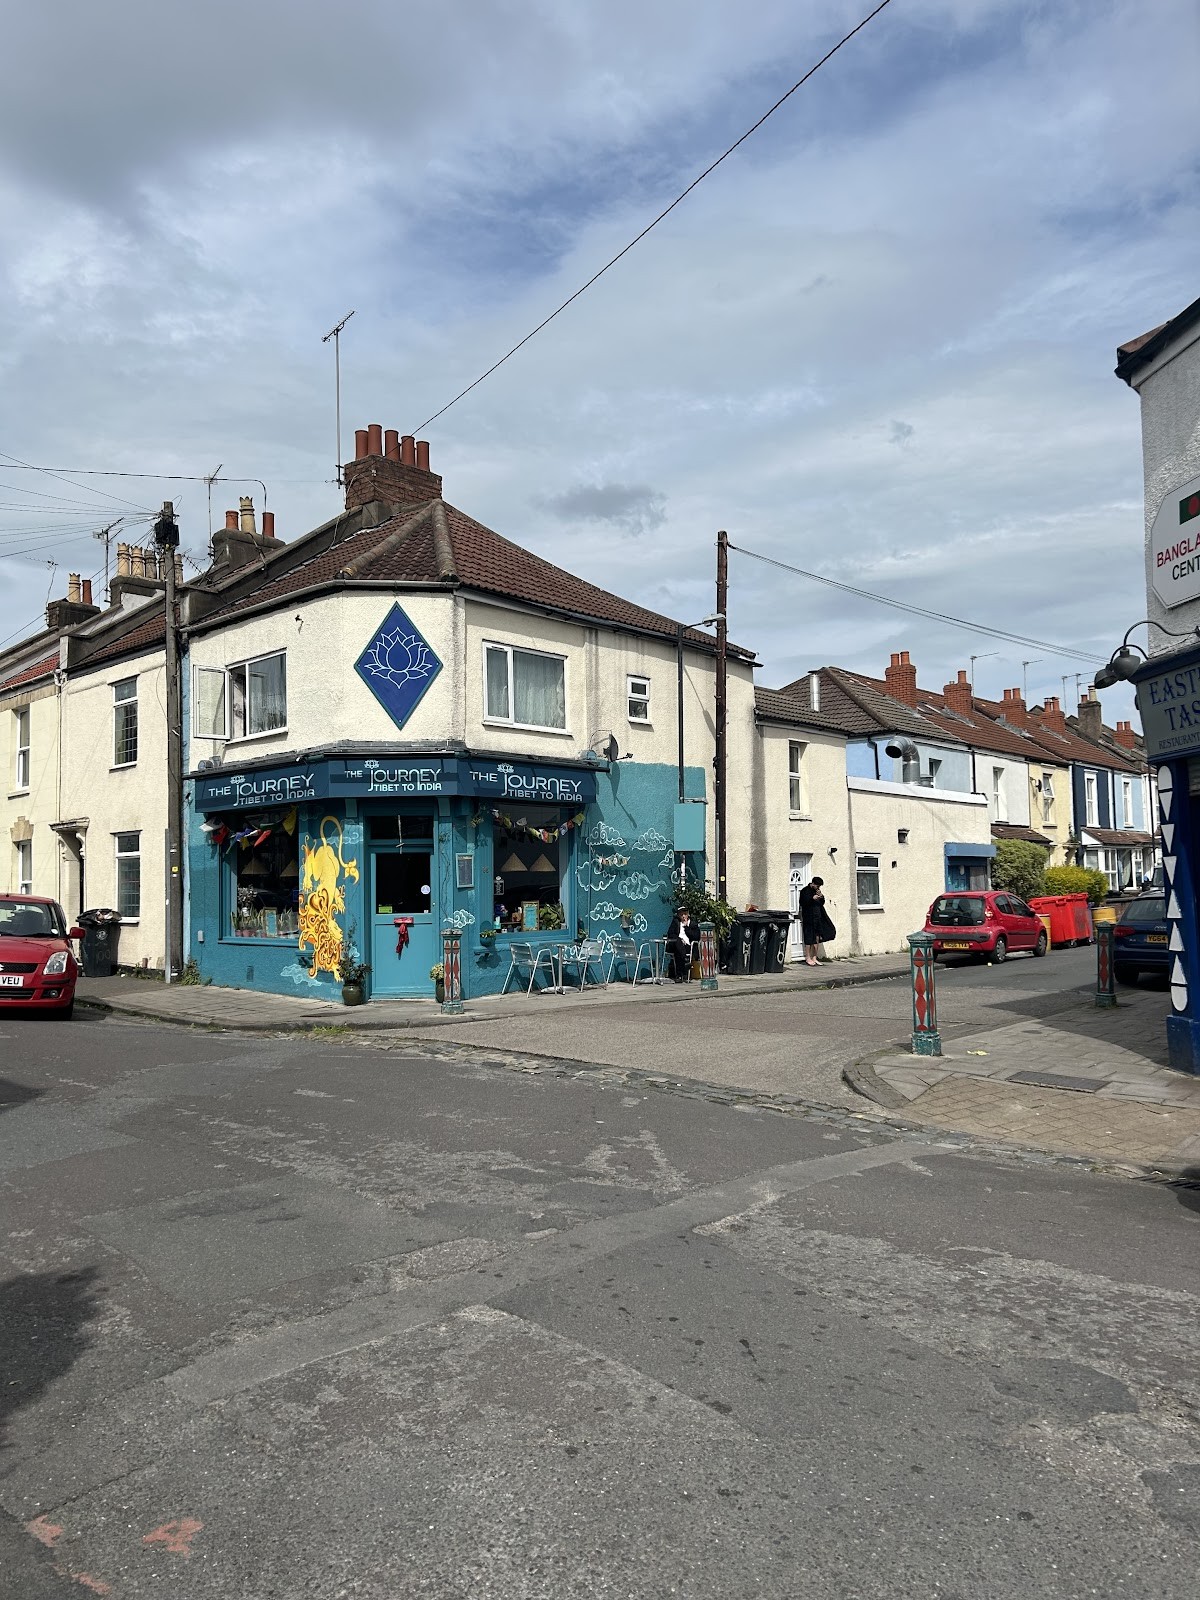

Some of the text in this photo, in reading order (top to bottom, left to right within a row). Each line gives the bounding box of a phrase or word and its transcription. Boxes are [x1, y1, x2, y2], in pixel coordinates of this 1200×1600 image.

[1172, 555, 1200, 580] CENT
[1148, 667, 1200, 705] EAST
[1164, 700, 1200, 730] TAS
[1159, 732, 1200, 749] RESTAURANT
[344, 770, 363, 778] THE
[469, 771, 498, 782] THE
[208, 786, 231, 797] THE
[374, 784, 400, 792] TIBET
[240, 794, 267, 805] TIBET
[270, 793, 283, 801] TO
[508, 789, 537, 798] TIBET
[540, 791, 554, 800] TO
[1, 976, 20, 985] VEU
